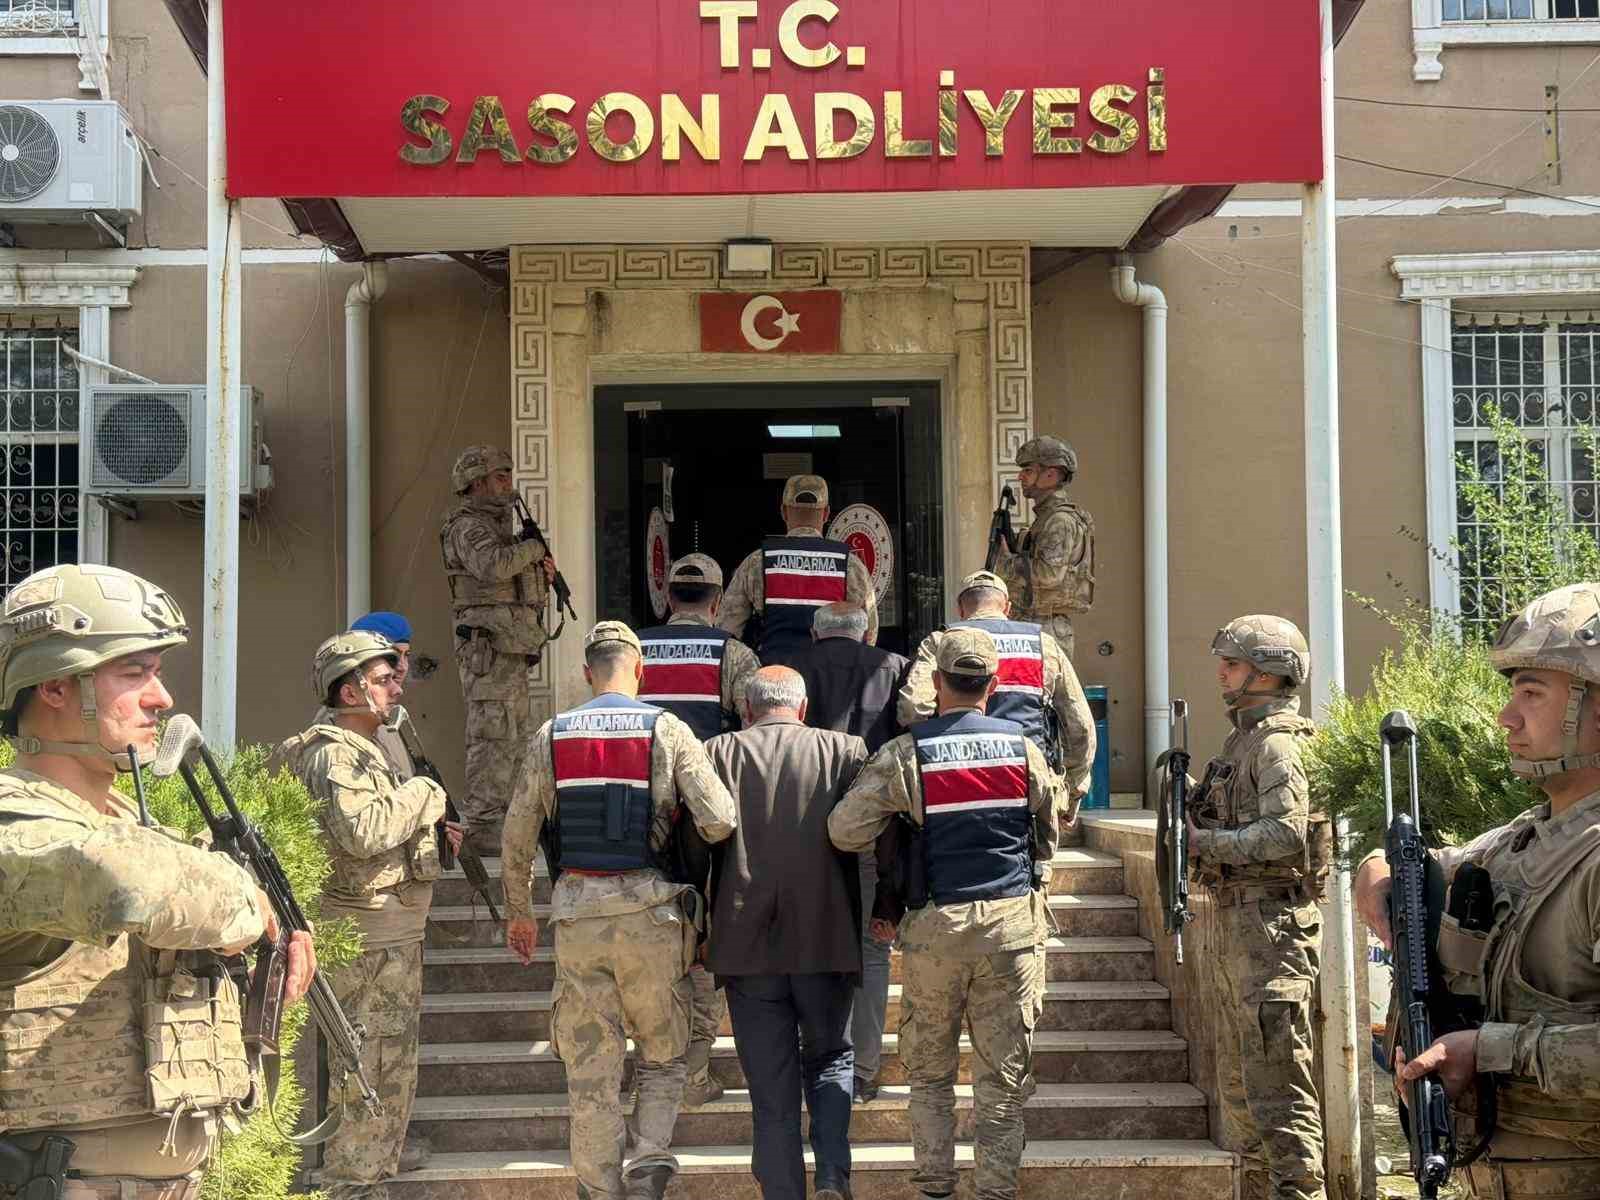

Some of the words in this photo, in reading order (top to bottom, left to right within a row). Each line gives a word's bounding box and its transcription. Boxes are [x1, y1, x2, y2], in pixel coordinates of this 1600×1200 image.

[699, 0, 866, 69] T.C.
[398, 92, 721, 165] SASON
[743, 67, 1168, 161] ADLİYESİ
[773, 553, 837, 573] JANDARMA
[566, 712, 645, 731] JANDARMA
[931, 739, 1015, 762] JANDARMA
